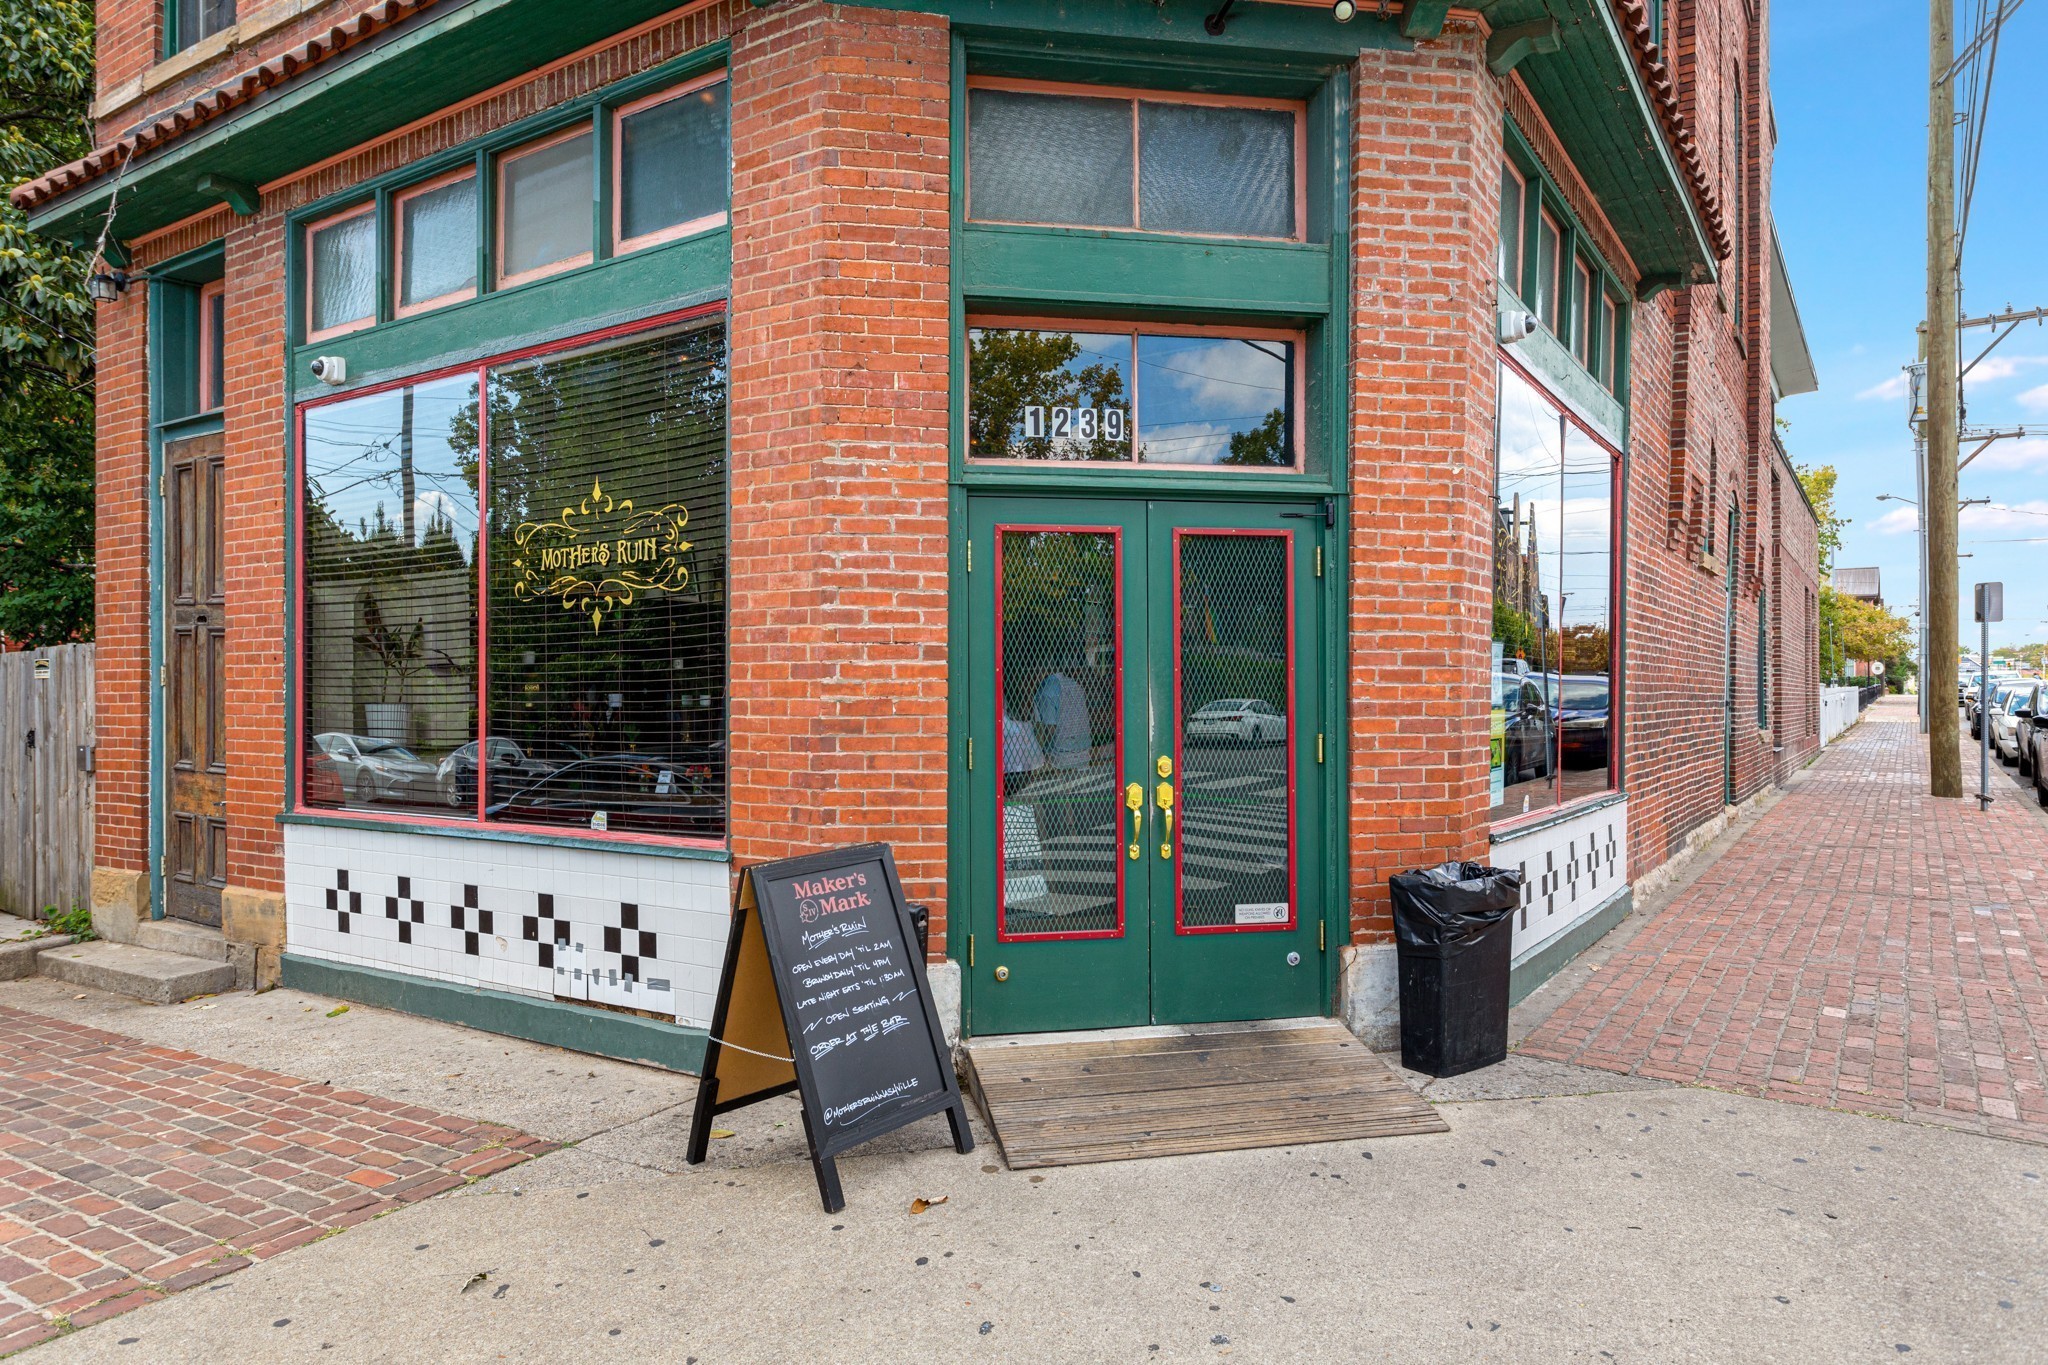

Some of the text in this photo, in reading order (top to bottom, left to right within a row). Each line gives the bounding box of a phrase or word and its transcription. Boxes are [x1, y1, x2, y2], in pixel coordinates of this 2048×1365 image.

[1030, 407, 1121, 439] 1239
[616, 538, 657, 564] RUIN
[792, 872, 867, 900] Maker's
[818, 891, 872, 916] Mark
[792, 960, 812, 974] OPEN
[814, 953, 838, 967] EVERY
[838, 948, 855, 960] DAY
[873, 940, 893, 952] 2AM
[802, 972, 834, 988] BRUNCH
[872, 956, 892, 968] 4PM
[796, 997, 817, 1010] LATE
[841, 982, 861, 994] EATS
[825, 995, 890, 1025] OPEN SEATING
[810, 1015, 908, 1055] ORDER AT THE BAR
